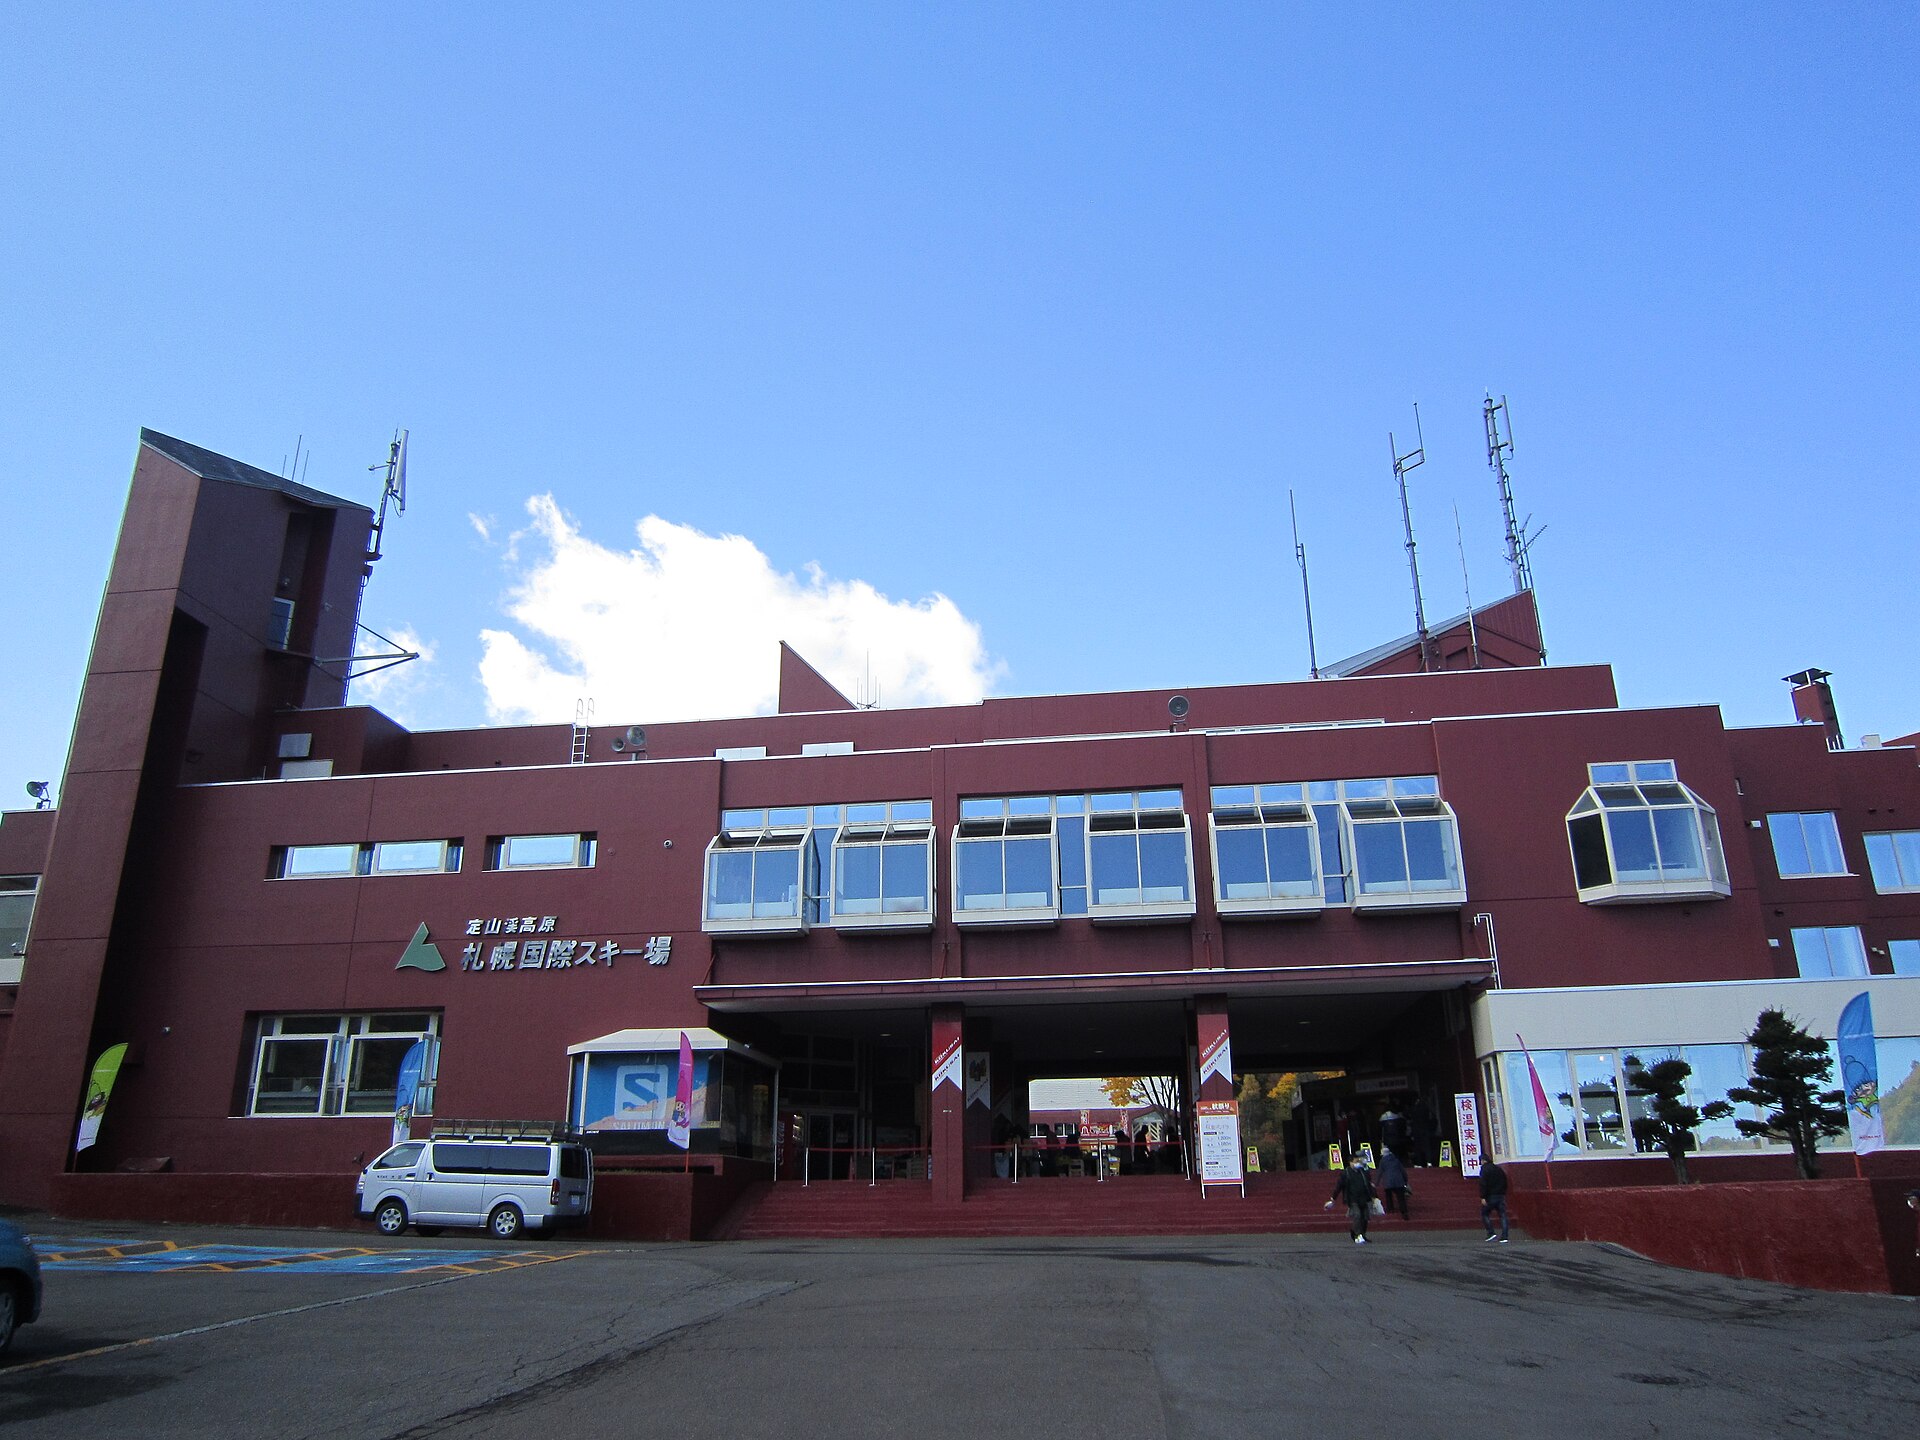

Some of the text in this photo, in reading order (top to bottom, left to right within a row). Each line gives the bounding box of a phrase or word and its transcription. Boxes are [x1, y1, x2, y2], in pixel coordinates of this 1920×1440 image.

[466, 915, 558, 935] 定山渓高原
[461, 936, 673, 971] 札幌国際スキー場
[1461, 1099, 1478, 1170] 検温実施中
